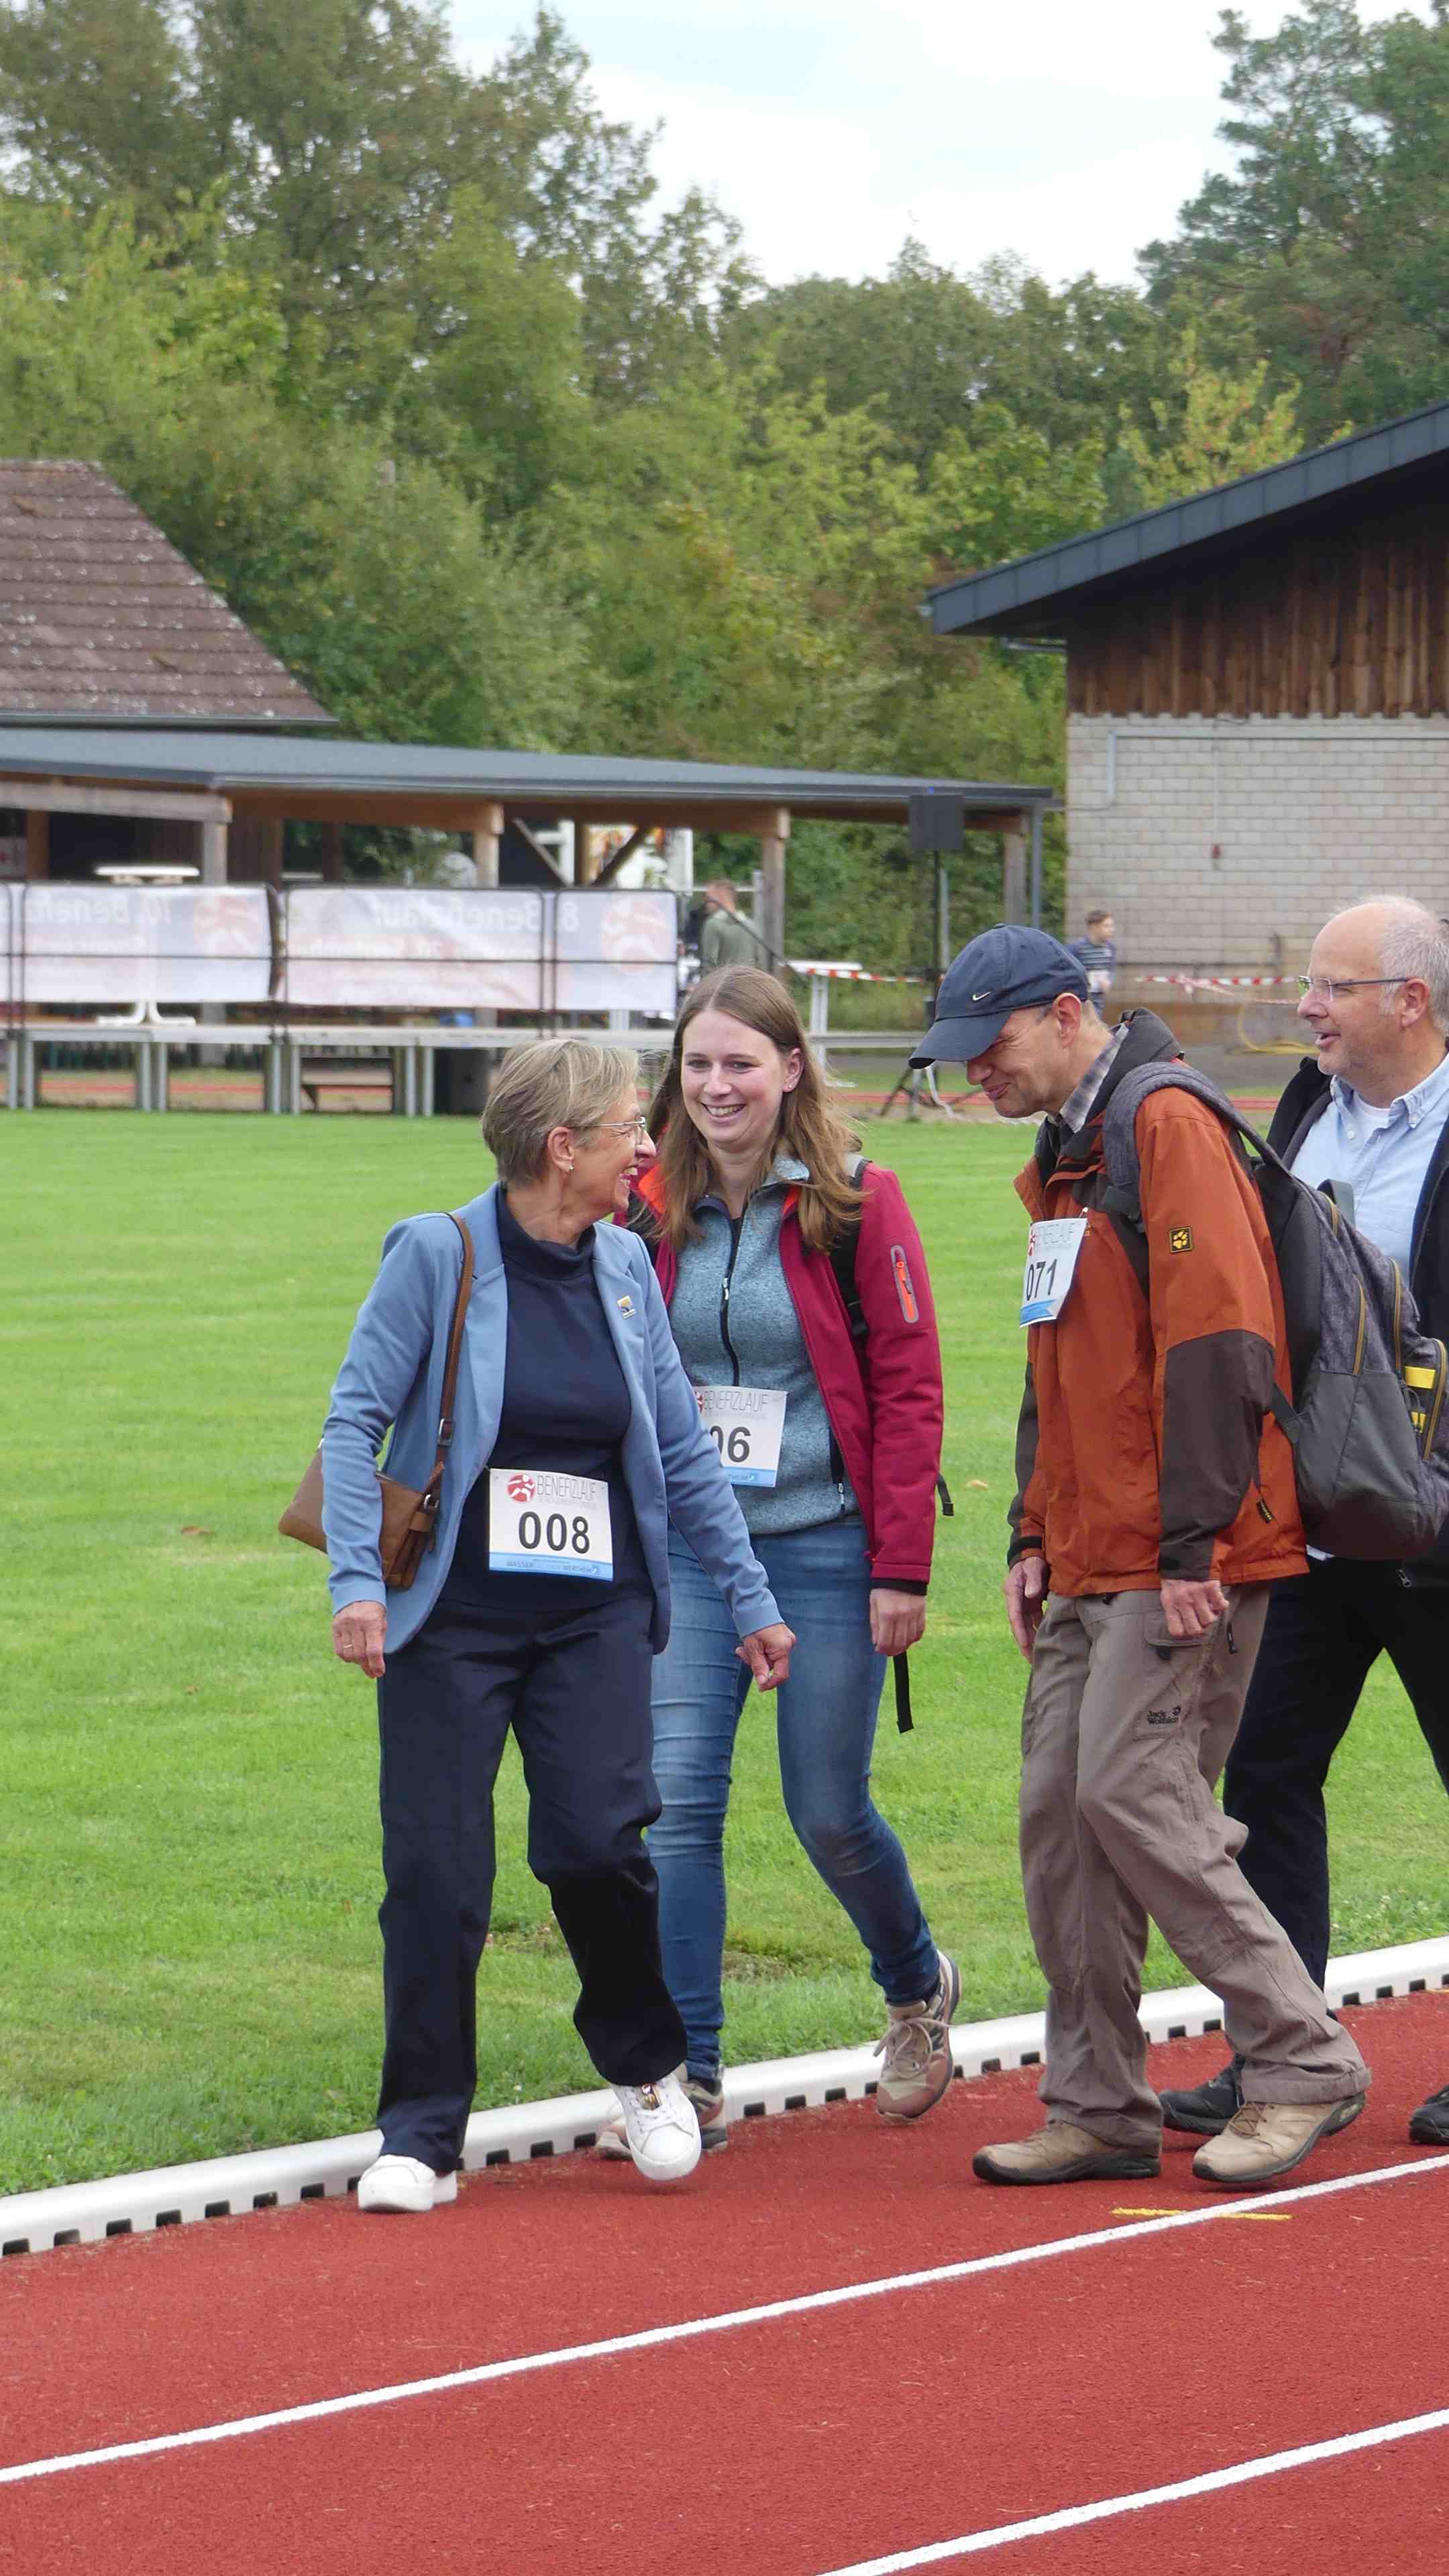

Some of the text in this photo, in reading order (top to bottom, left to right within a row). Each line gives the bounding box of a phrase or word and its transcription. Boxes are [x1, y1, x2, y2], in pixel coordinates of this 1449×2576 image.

[1026, 1258, 1058, 1301] 071
[704, 1390, 768, 1412] BENEFIZLAUF
[537, 1475, 596, 1501] BENEFIZLAUF
[519, 1511, 590, 1554] 008
